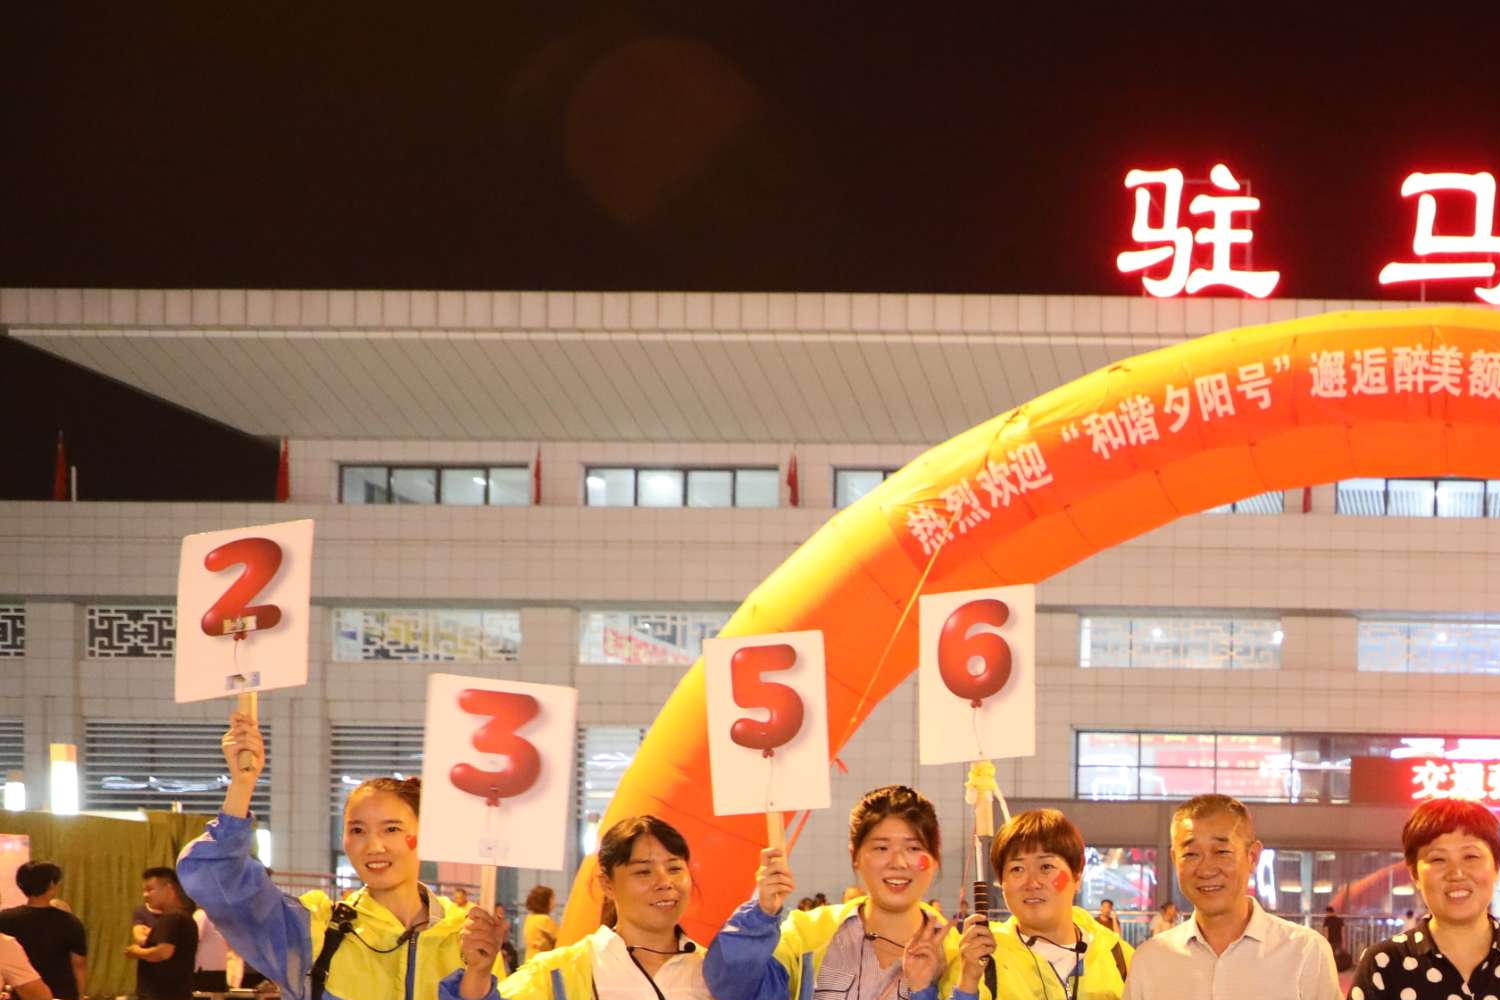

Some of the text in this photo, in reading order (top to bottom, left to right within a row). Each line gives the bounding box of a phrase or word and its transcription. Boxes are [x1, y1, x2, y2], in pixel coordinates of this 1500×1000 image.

[202, 537, 283, 637] 2
[730, 644, 804, 750] 5
[938, 598, 1011, 699] 6
[450, 689, 541, 799] 3
